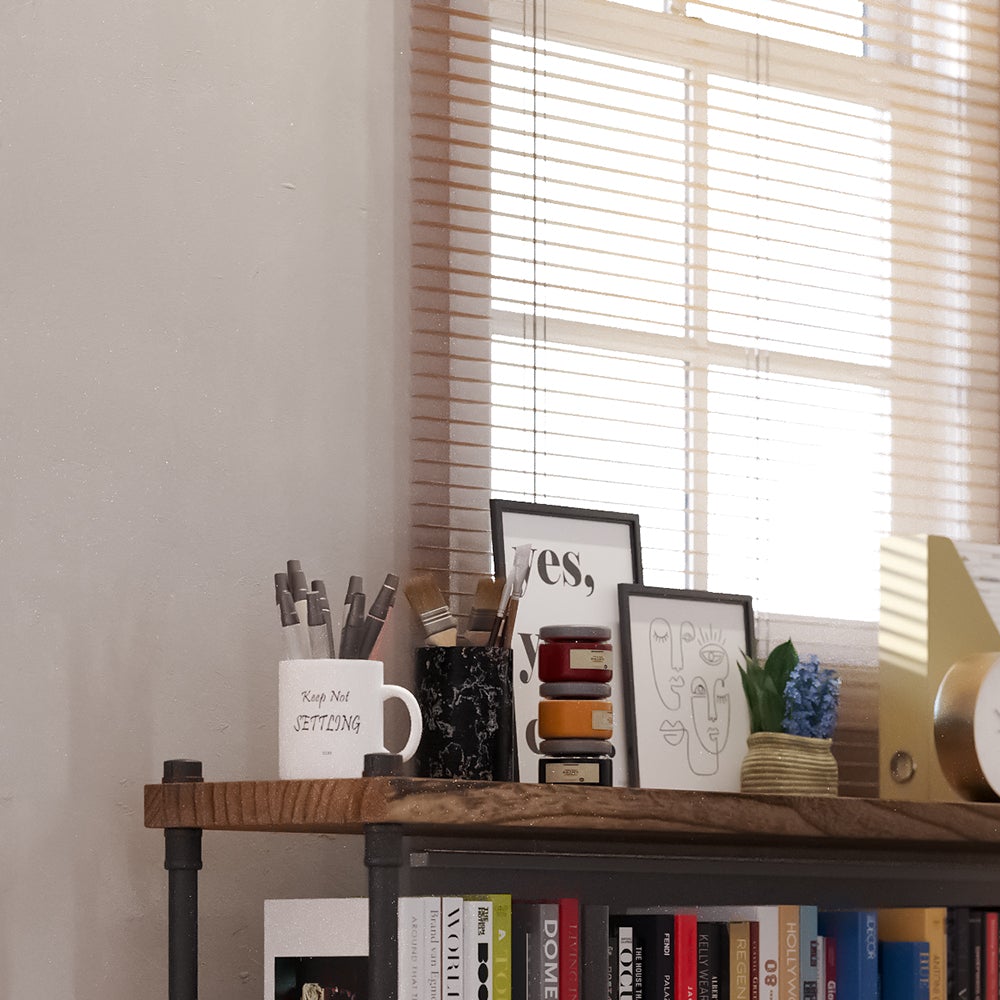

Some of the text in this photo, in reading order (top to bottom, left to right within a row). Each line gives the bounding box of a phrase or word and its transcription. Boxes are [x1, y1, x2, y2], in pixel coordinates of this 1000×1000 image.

[301, 690, 350, 709] Keep Not
[294, 714, 361, 734] SETTLING
[410, 917, 419, 961] AROUND
[430, 910, 439, 943] Brand
[430, 947, 438, 967] van
[568, 925, 578, 982] LIVING
[698, 934, 709, 967] KELLY
[410, 966, 419, 991] THAT
[764, 959, 777, 987] 80
